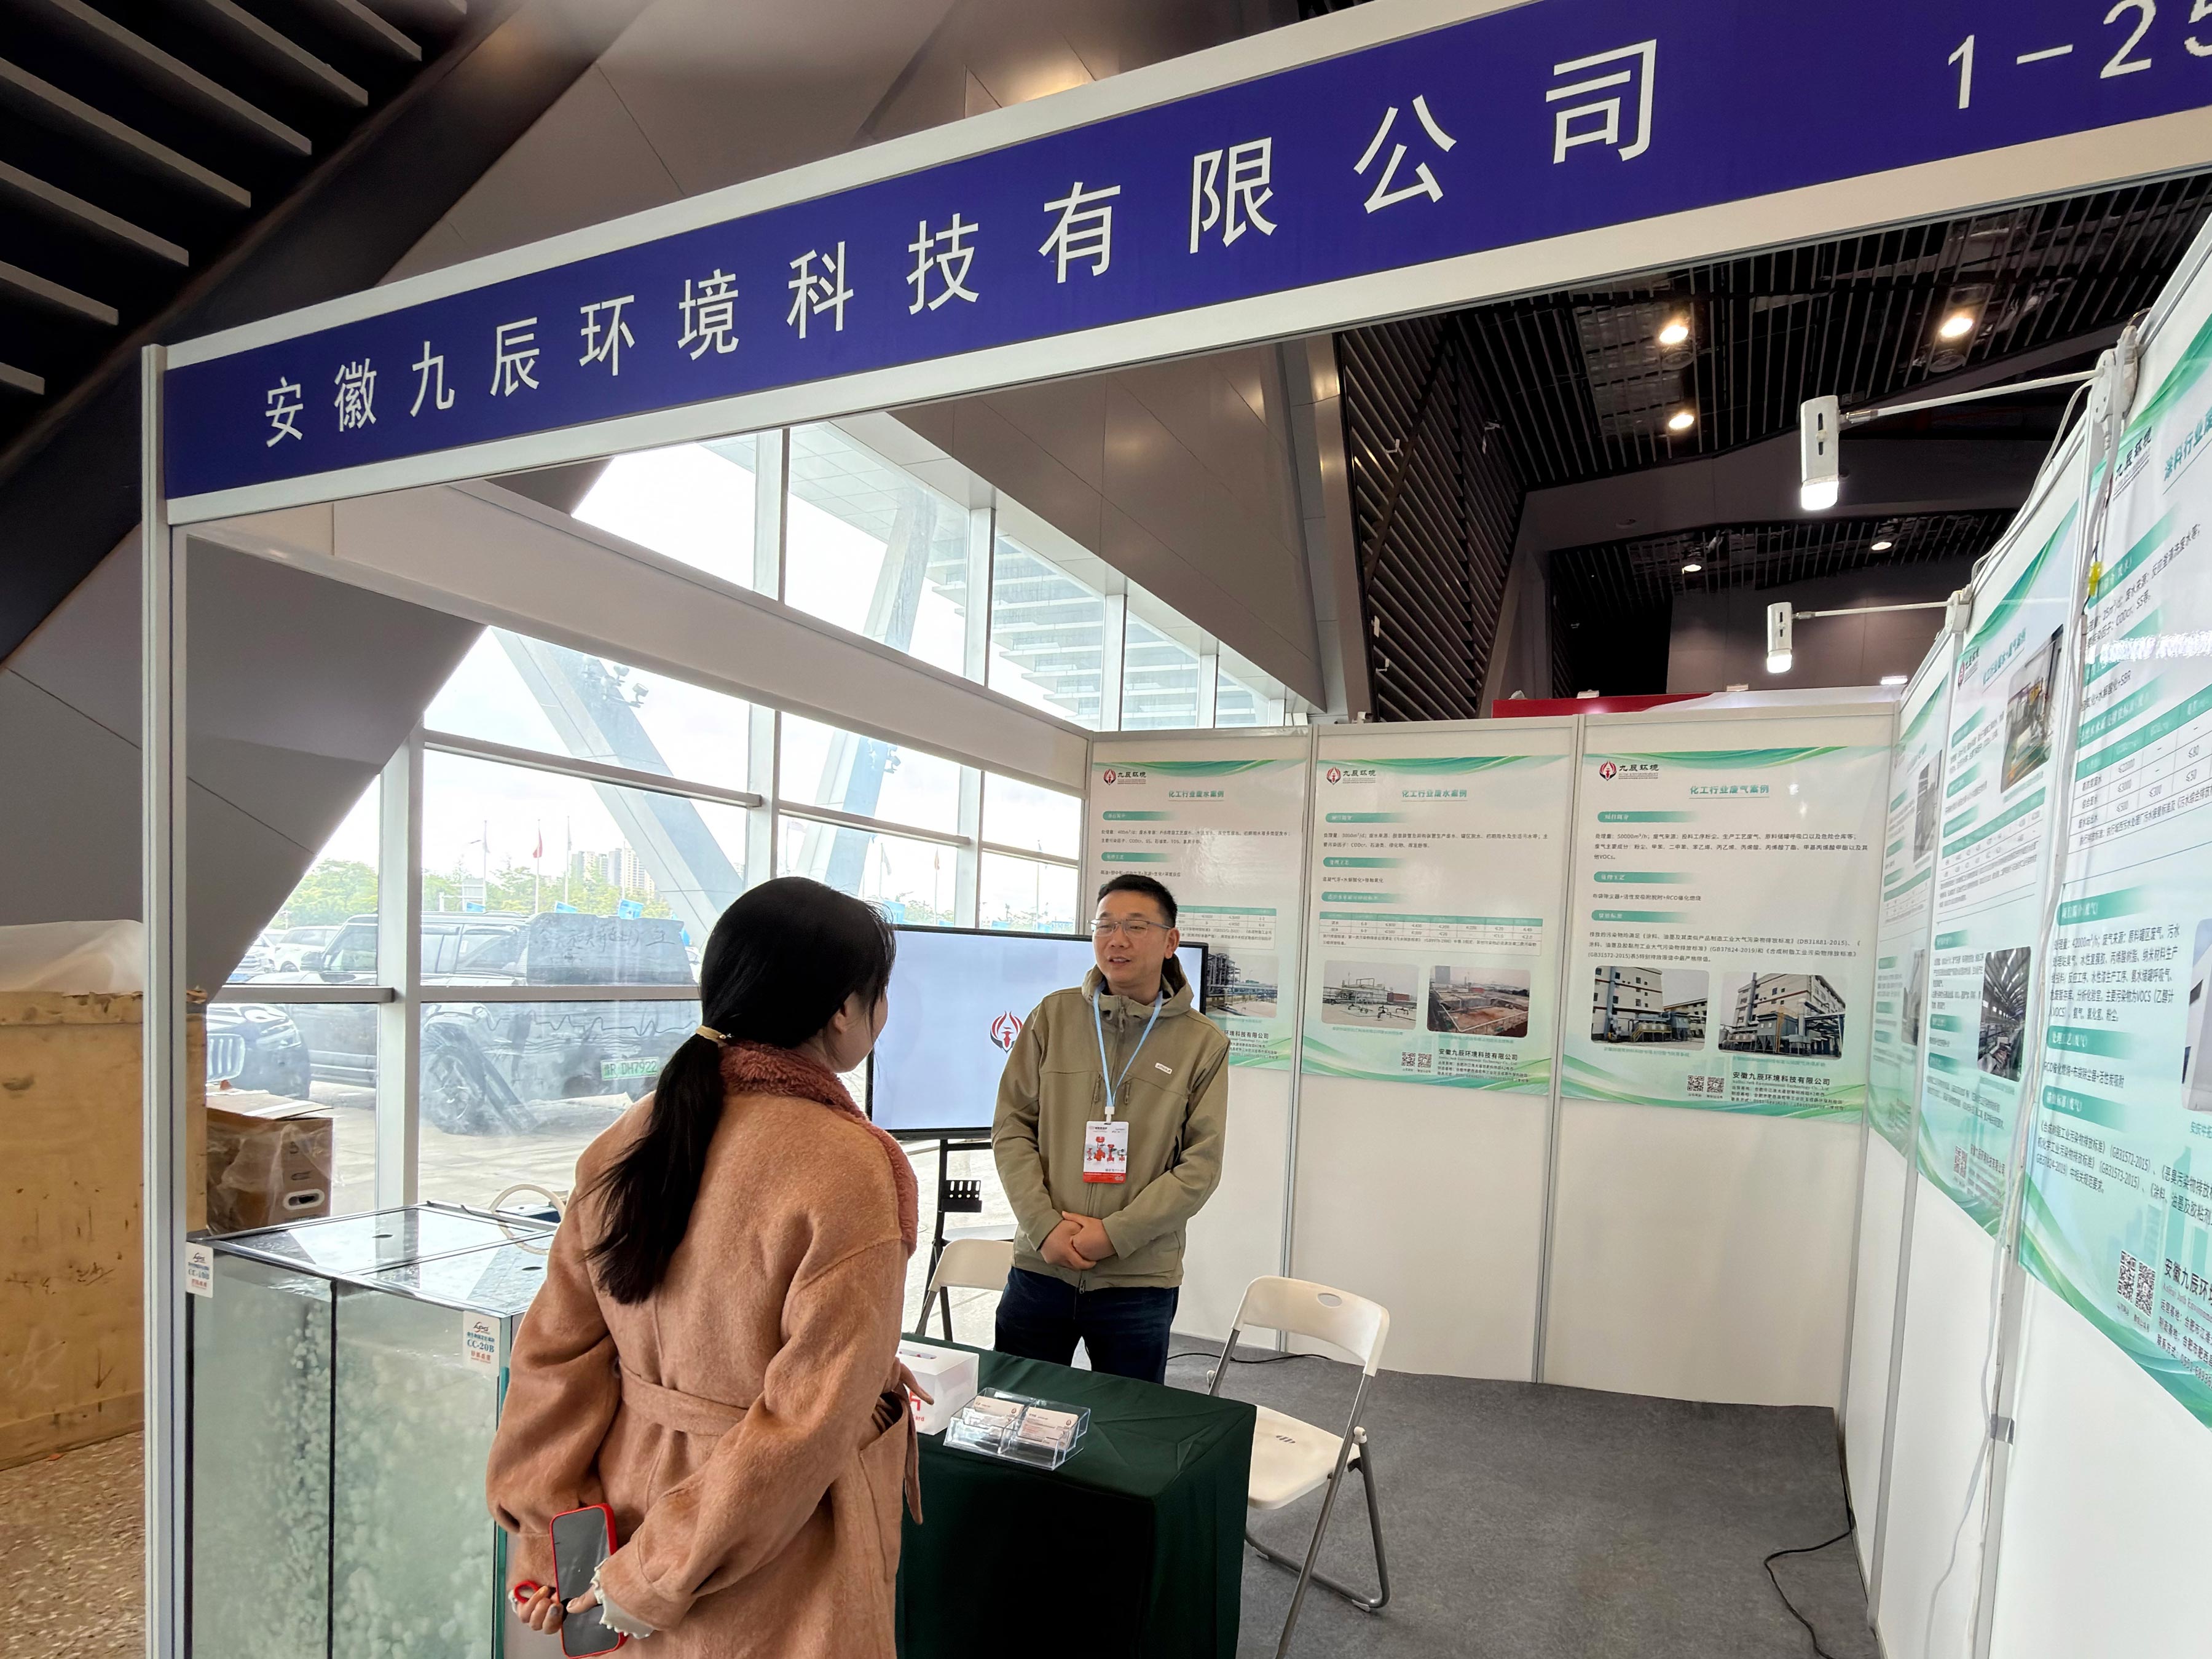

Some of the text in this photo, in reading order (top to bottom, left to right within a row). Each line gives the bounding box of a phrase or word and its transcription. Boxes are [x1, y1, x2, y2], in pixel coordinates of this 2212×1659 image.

[265, 38, 1657, 448] 安徽九辰环境科技有限公司
[1618, 763, 1659, 772] 九辰环境
[1690, 785, 1769, 795] 化工行业废气案例
[1438, 1049, 1517, 1060] 安徽九辰环境科技有限公司
[1733, 1071, 1830, 1086] 安徽九辰环境科技有限公司
[467, 1339, 494, 1353] CC-20B
